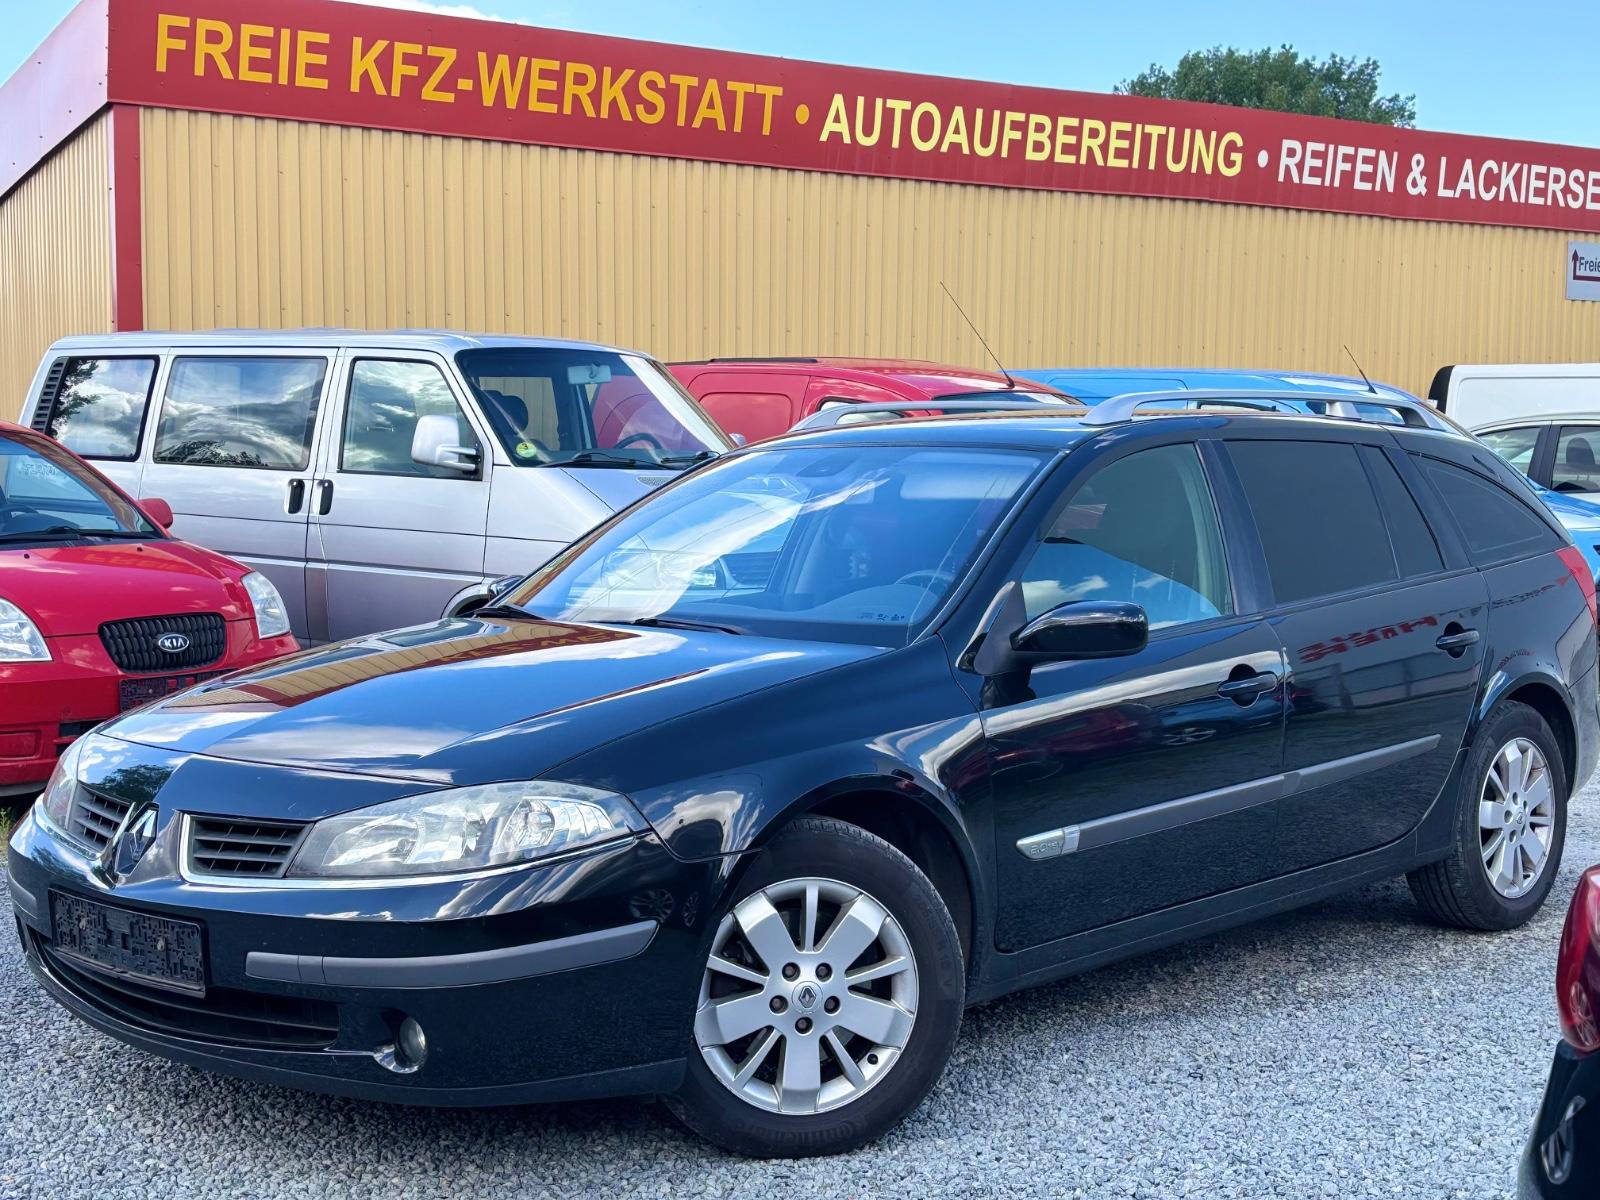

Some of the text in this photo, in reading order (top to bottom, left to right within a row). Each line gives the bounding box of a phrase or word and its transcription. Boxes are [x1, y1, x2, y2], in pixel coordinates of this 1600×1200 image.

[155, 13, 1600, 211] FREIE KFZ-WERKSTATT AUTOAUFBEREITUNG REIFEN & LACKIERSE
[163, 637, 186, 649] KIA
